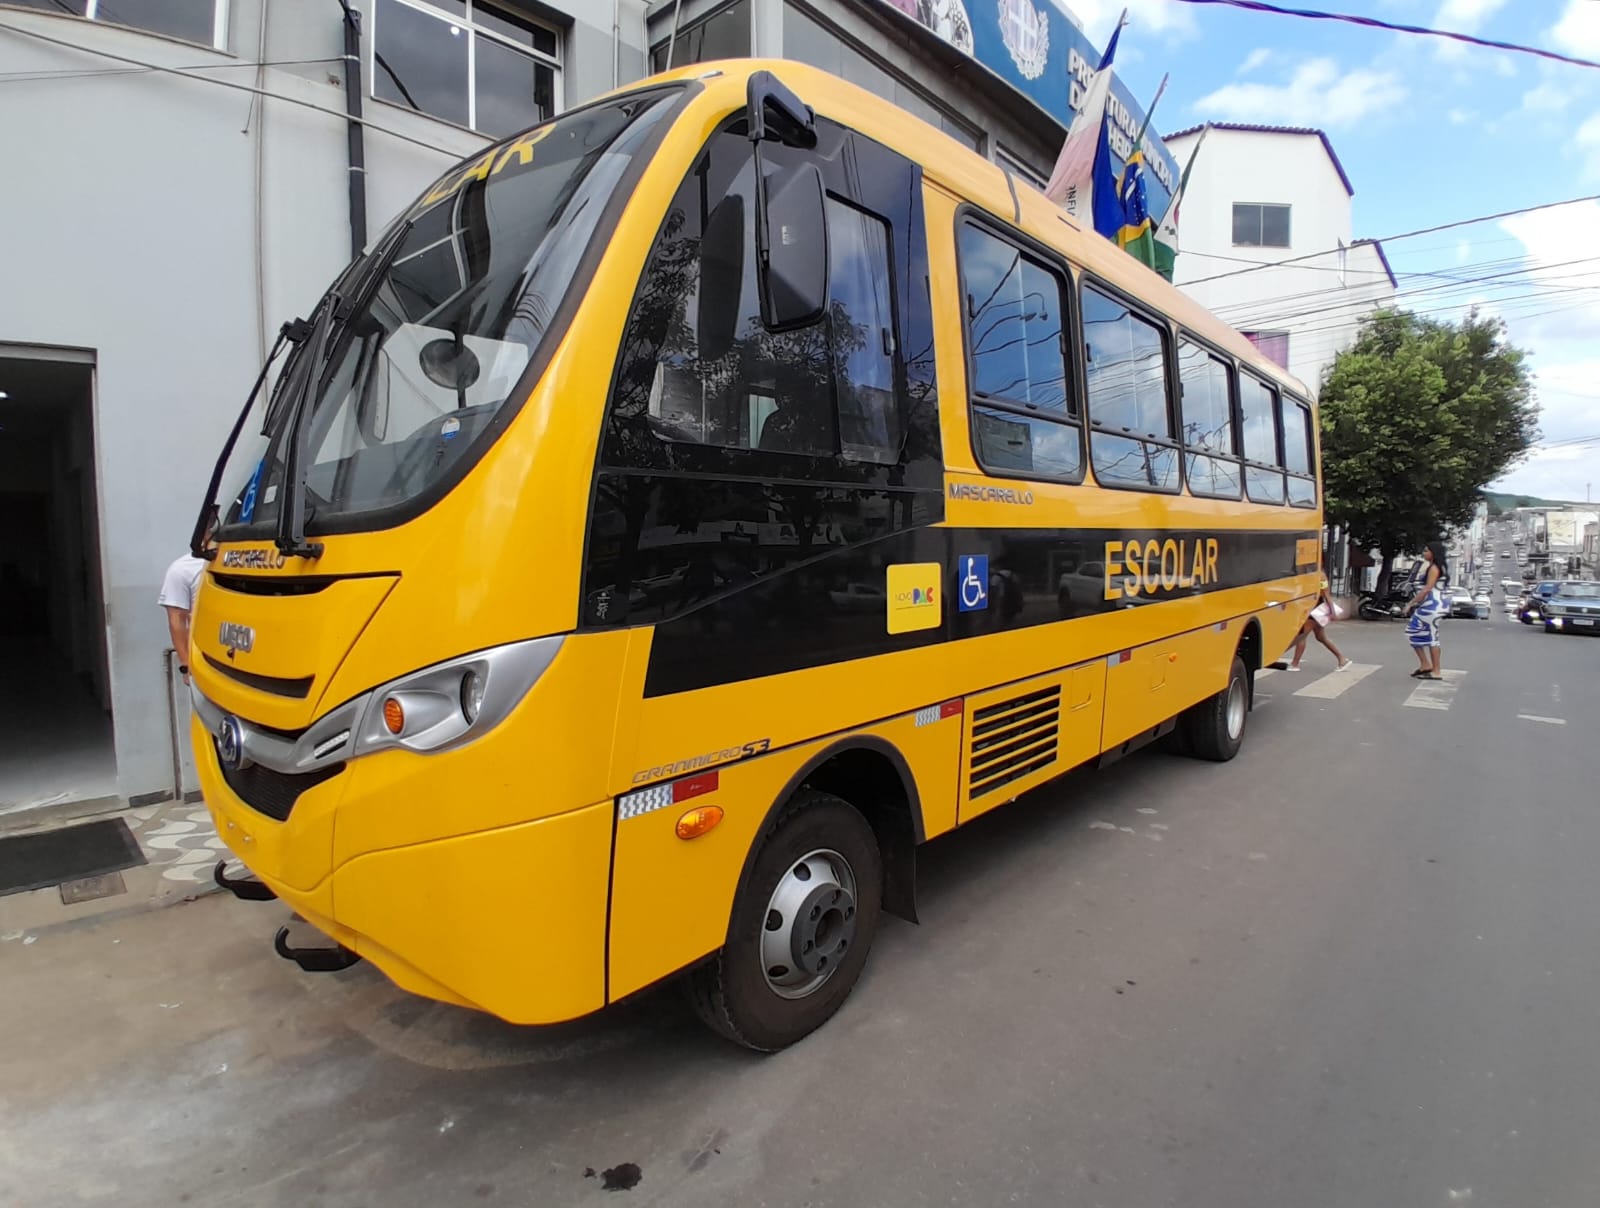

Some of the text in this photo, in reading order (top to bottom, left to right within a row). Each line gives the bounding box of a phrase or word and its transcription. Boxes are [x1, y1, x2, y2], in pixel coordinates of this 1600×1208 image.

[949, 483, 1034, 505] MASCARELLO
[1104, 538, 1219, 601] ESCOLAR
[912, 587, 934, 605] PAC
